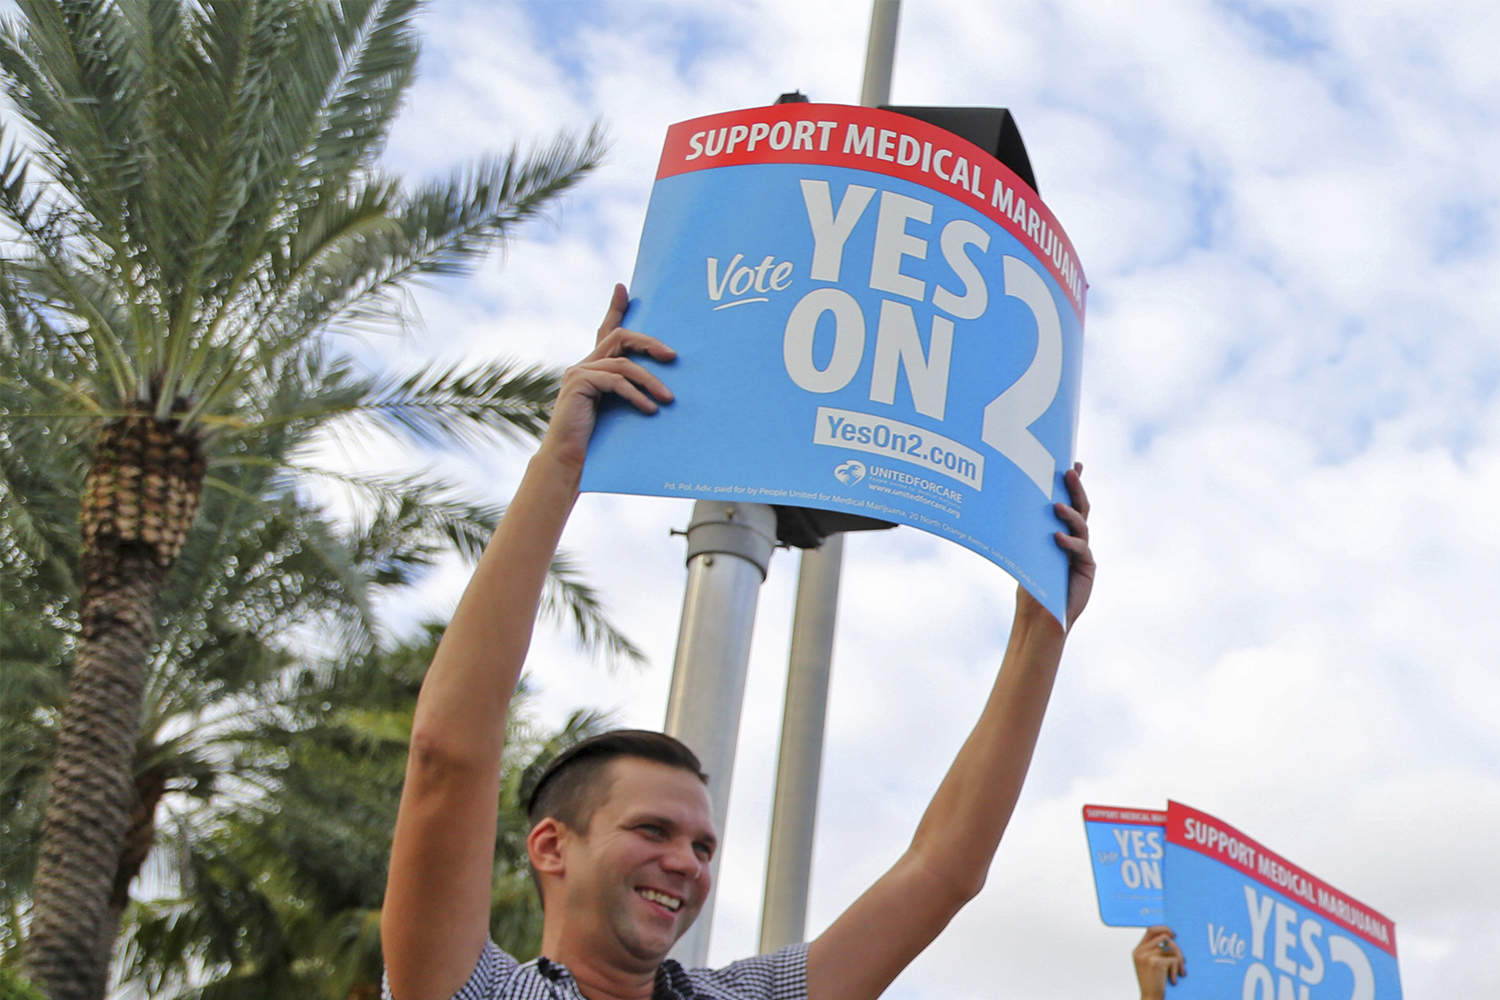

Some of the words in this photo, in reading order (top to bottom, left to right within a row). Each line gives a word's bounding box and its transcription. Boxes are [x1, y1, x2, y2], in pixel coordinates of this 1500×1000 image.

[685, 120, 838, 161] SUPPORT
[842, 123, 986, 200] MEDICAL
[990, 177, 1083, 310] MARIJUANA
[800, 178, 992, 321] YES
[705, 253, 794, 301] Vote
[782, 286, 956, 422] ON
[980, 254, 1064, 501] 2
[826, 414, 977, 482] YesOn2.com
[869, 465, 964, 504] UNITEDFORCARE
[1111, 827, 1164, 860] YES
[1120, 858, 1164, 890] ON
[1184, 817, 1256, 869] SUPPORT
[1257, 853, 1317, 904] MEDICAL
[1317, 887, 1390, 945] MARIJUANA
[1207, 922, 1247, 959] Vote
[1243, 884, 1326, 986] YES
